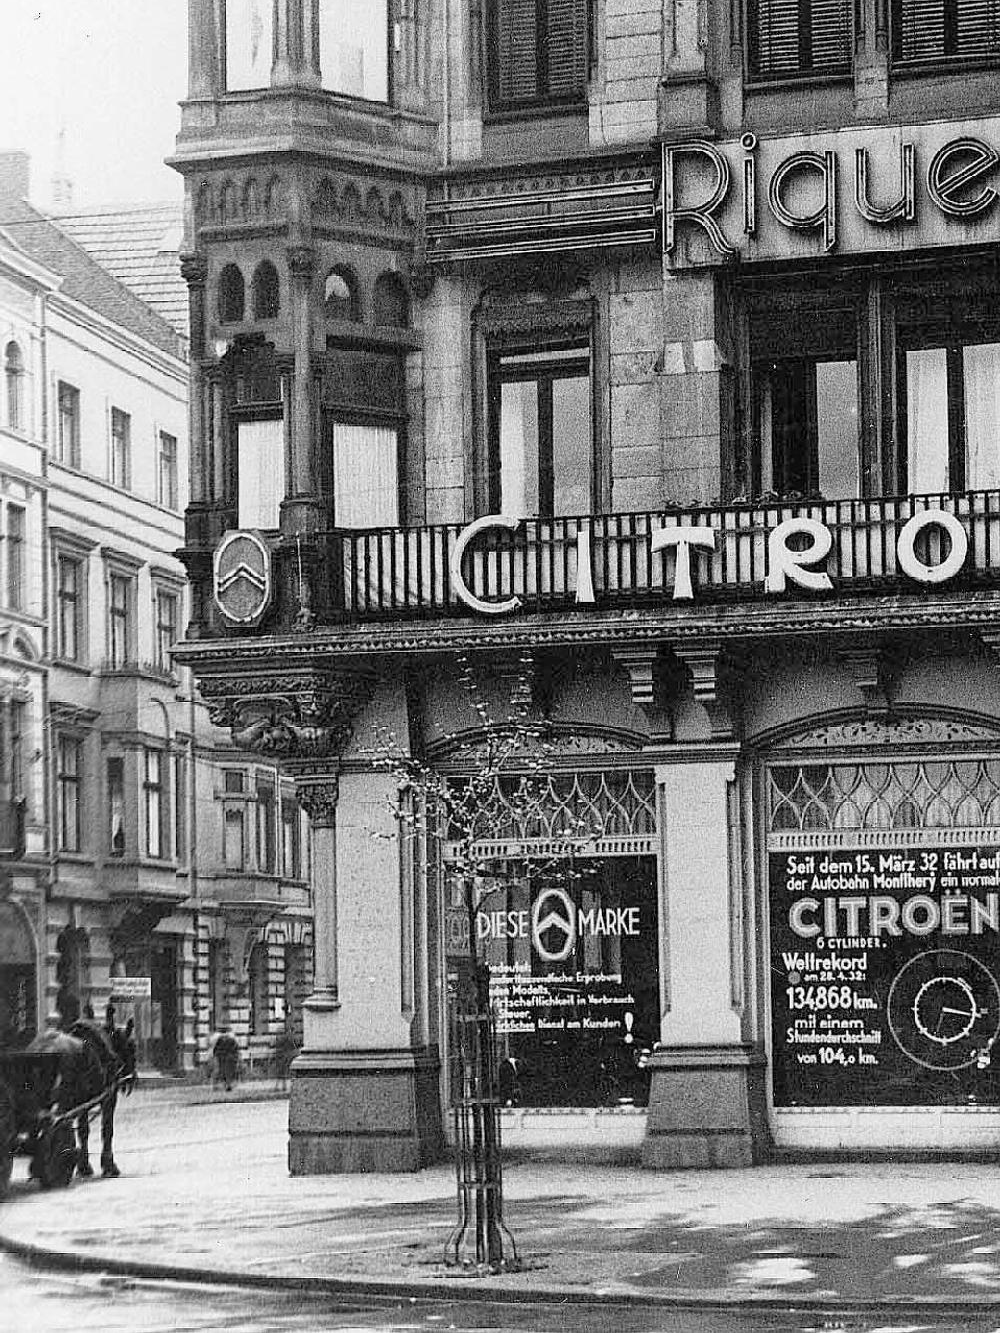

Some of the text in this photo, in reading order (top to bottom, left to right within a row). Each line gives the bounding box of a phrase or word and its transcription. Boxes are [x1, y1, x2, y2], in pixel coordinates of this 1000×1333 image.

[786, 855, 815, 875] Seit
[819, 856, 852, 874] dem
[855, 854, 876, 873] 15.
[879, 853, 916, 873] März
[920, 852, 938, 871] 32
[943, 851, 978, 871] fährt
[786, 875, 808, 891] der
[811, 873, 869, 891] Autobahn
[941, 872, 958, 888] ein
[476, 907, 641, 939] DIESE MARKE
[788, 889, 1000, 938] CITROËN
[817, 936, 825, 949] 6
[782, 952, 868, 971] Weltrekord
[853, 991, 878, 1010] km.
[795, 1013, 864, 1029] mit einem
[797, 1053, 817, 1064] von
[858, 1046, 879, 1065] km.
